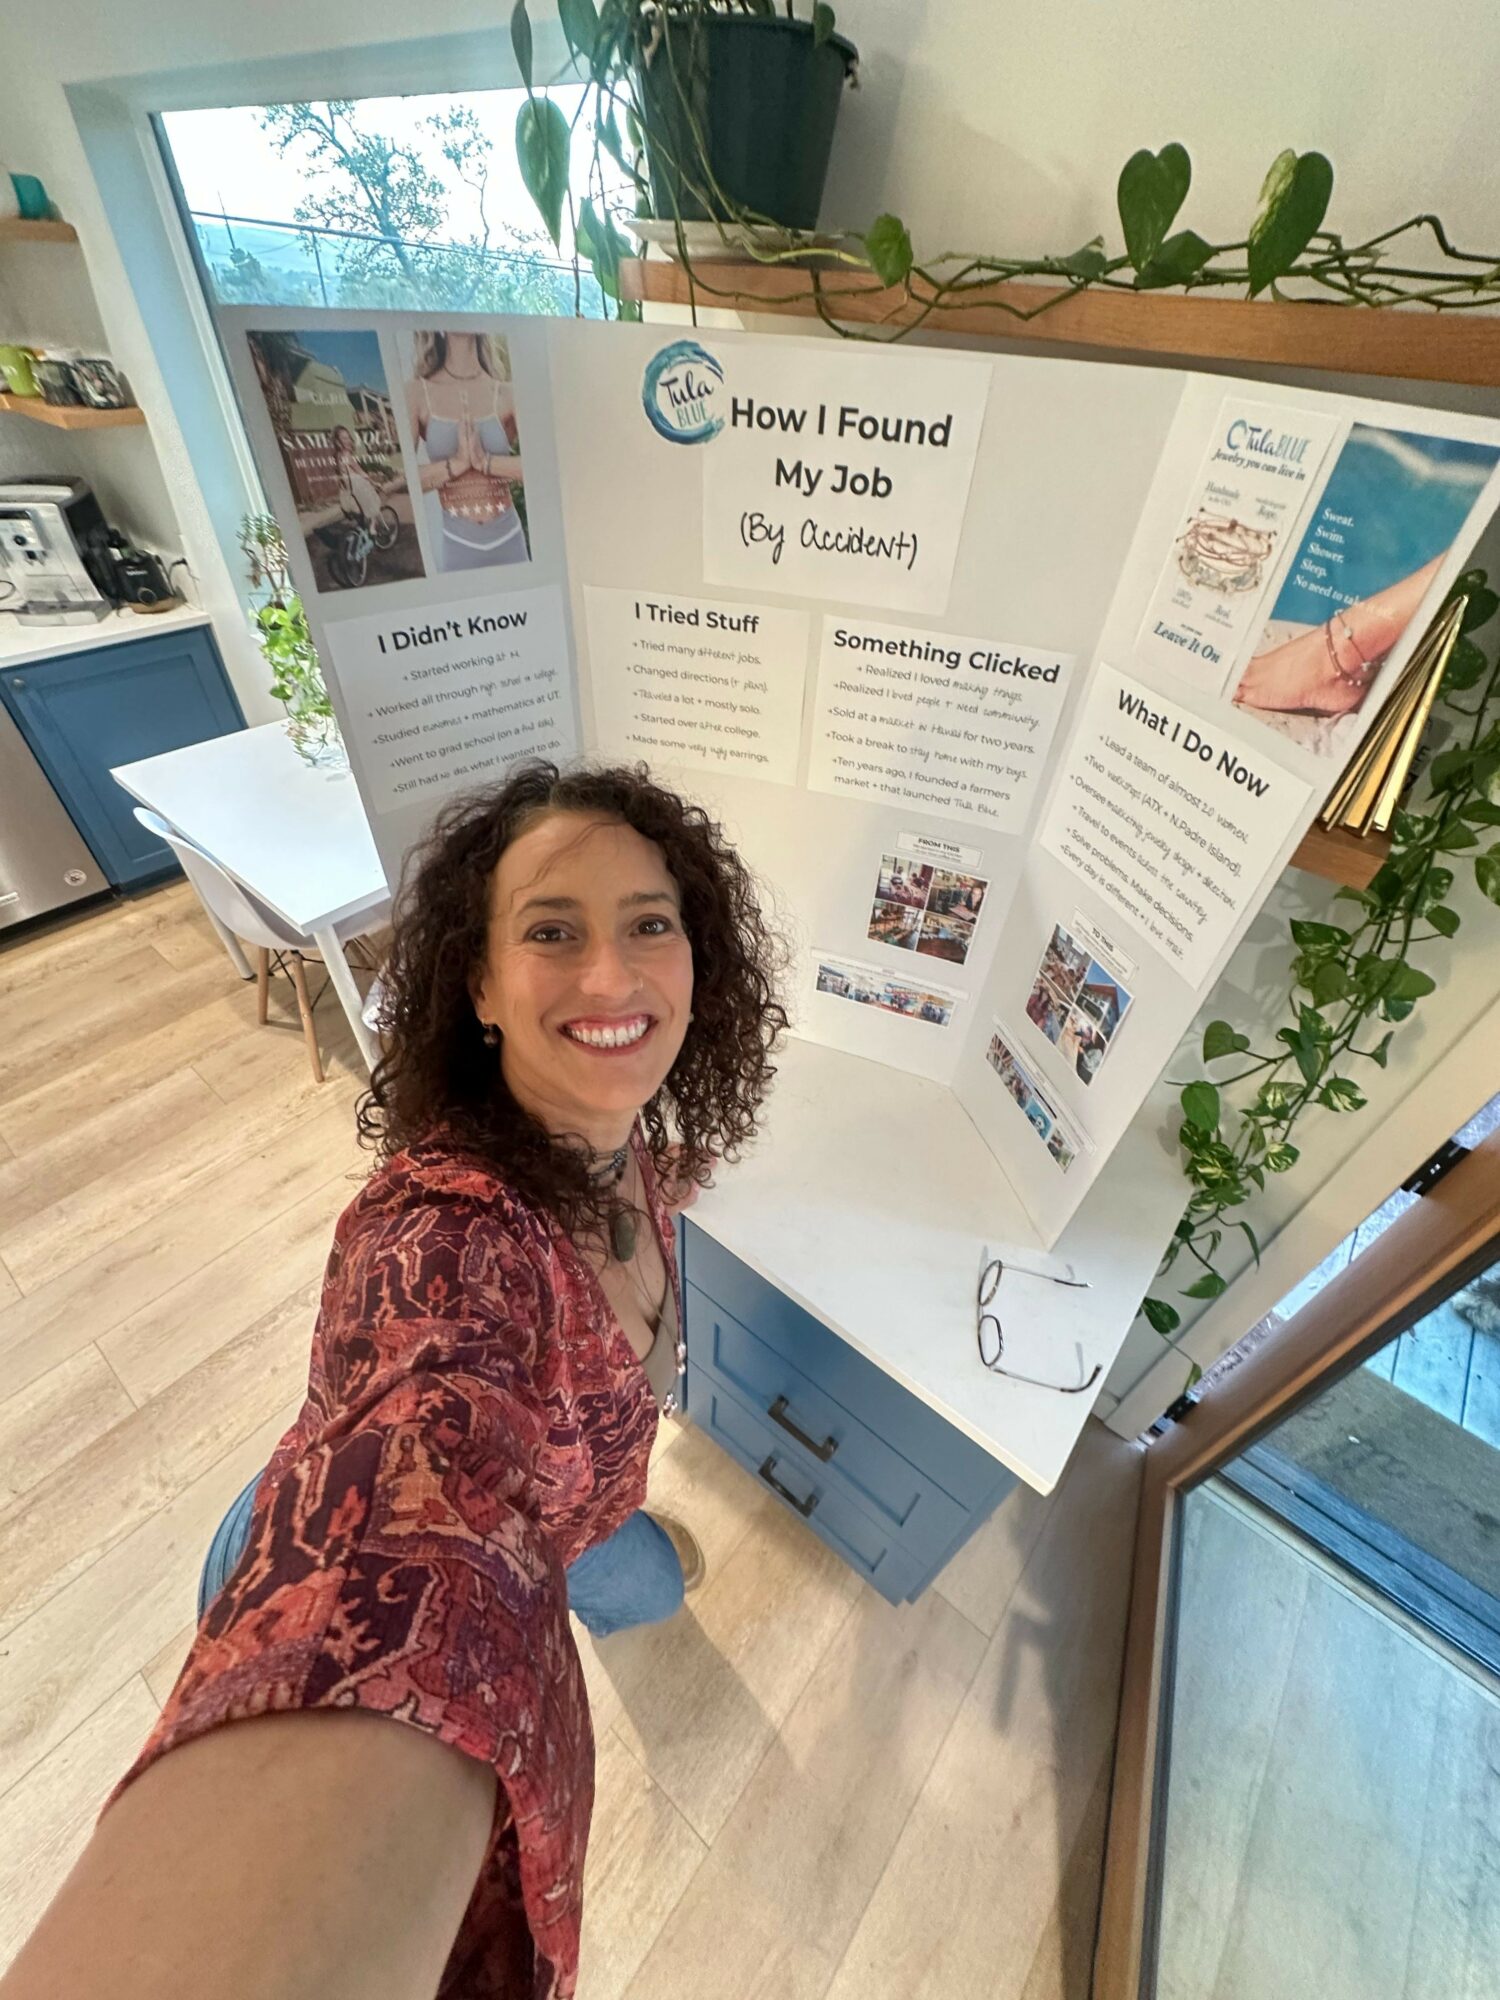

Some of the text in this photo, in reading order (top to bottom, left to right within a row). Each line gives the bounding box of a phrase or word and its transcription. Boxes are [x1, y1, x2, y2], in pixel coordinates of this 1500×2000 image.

[659, 370, 714, 408] Tula
[731, 397, 952, 447] How I Found
[775, 458, 892, 498] My Job
[1211, 448, 1306, 481] Jewelry you can live in
[1322, 507, 1355, 528] Sweat.
[740, 511, 785, 565] (By
[1315, 525, 1345, 544] Swim.
[1307, 541, 1345, 563] Shower.
[1300, 558, 1328, 579] Sleep.
[1293, 573, 1343, 601] No need to
[378, 612, 527, 653] I Didn't Know
[635, 602, 759, 634] I Tried Stuff
[640, 640, 665, 652] Tried
[667, 645, 696, 658] many
[834, 630, 1060, 683] Something Clicked
[1153, 621, 1188, 646] Leave
[1188, 638, 1200, 653] It
[1201, 644, 1221, 664] On
[410, 656, 495, 681] Started working
[633, 664, 729, 686] Changed directions
[866, 664, 912, 680] Realized
[920, 673, 951, 688] loved
[375, 698, 419, 717] Worked
[422, 695, 434, 706] all
[435, 685, 478, 703] through
[682, 695, 695, 705] lot
[705, 700, 738, 713] mostly
[839, 681, 884, 697] Realized
[377, 726, 420, 744] Studied
[472, 699, 535, 720] mathematics
[536, 695, 546, 704] at
[641, 713, 676, 726] Started
[677, 720, 698, 728] over
[833, 707, 856, 719] Sold
[858, 713, 868, 721] at
[963, 730, 979, 742] for
[981, 735, 1002, 747] two
[395, 753, 424, 767] Went
[425, 750, 437, 759] to
[438, 742, 463, 757] grad
[464, 733, 496, 749] school
[497, 730, 512, 741] (on
[632, 734, 658, 745] Made
[660, 740, 686, 749] some
[831, 731, 855, 743] Took
[865, 737, 895, 751] break
[897, 744, 908, 754] to
[960, 758, 984, 769] with
[986, 763, 1004, 775] my
[1119, 689, 1270, 797] What I Do Now
[397, 779, 417, 793] Still
[418, 773, 439, 786] had
[470, 758, 494, 771] what
[501, 746, 538, 763] wanted
[537, 744, 547, 752] to
[838, 756, 855, 768] Ten
[856, 762, 883, 773] years
[915, 772, 959, 789] founded
[970, 783, 1010, 800] farmers
[1105, 736, 1127, 757] Lead
[1133, 756, 1157, 778] team
[1168, 780, 1202, 809] almost
[834, 776, 870, 789] market
[880, 784, 901, 795] that
[903, 788, 951, 806] launched
[1075, 776, 1106, 805] Oversee
[1142, 794, 1163, 815] (ATX
[918, 838, 941, 848] FROM
[1079, 806, 1101, 829] Travel
[1110, 834, 1137, 859] events
[1063, 845, 1084, 868] Every
[1084, 864, 1099, 880] day
[1105, 883, 1139, 917] different
[1071, 829, 1092, 851] Solve
[1131, 879, 1153, 904] Make
